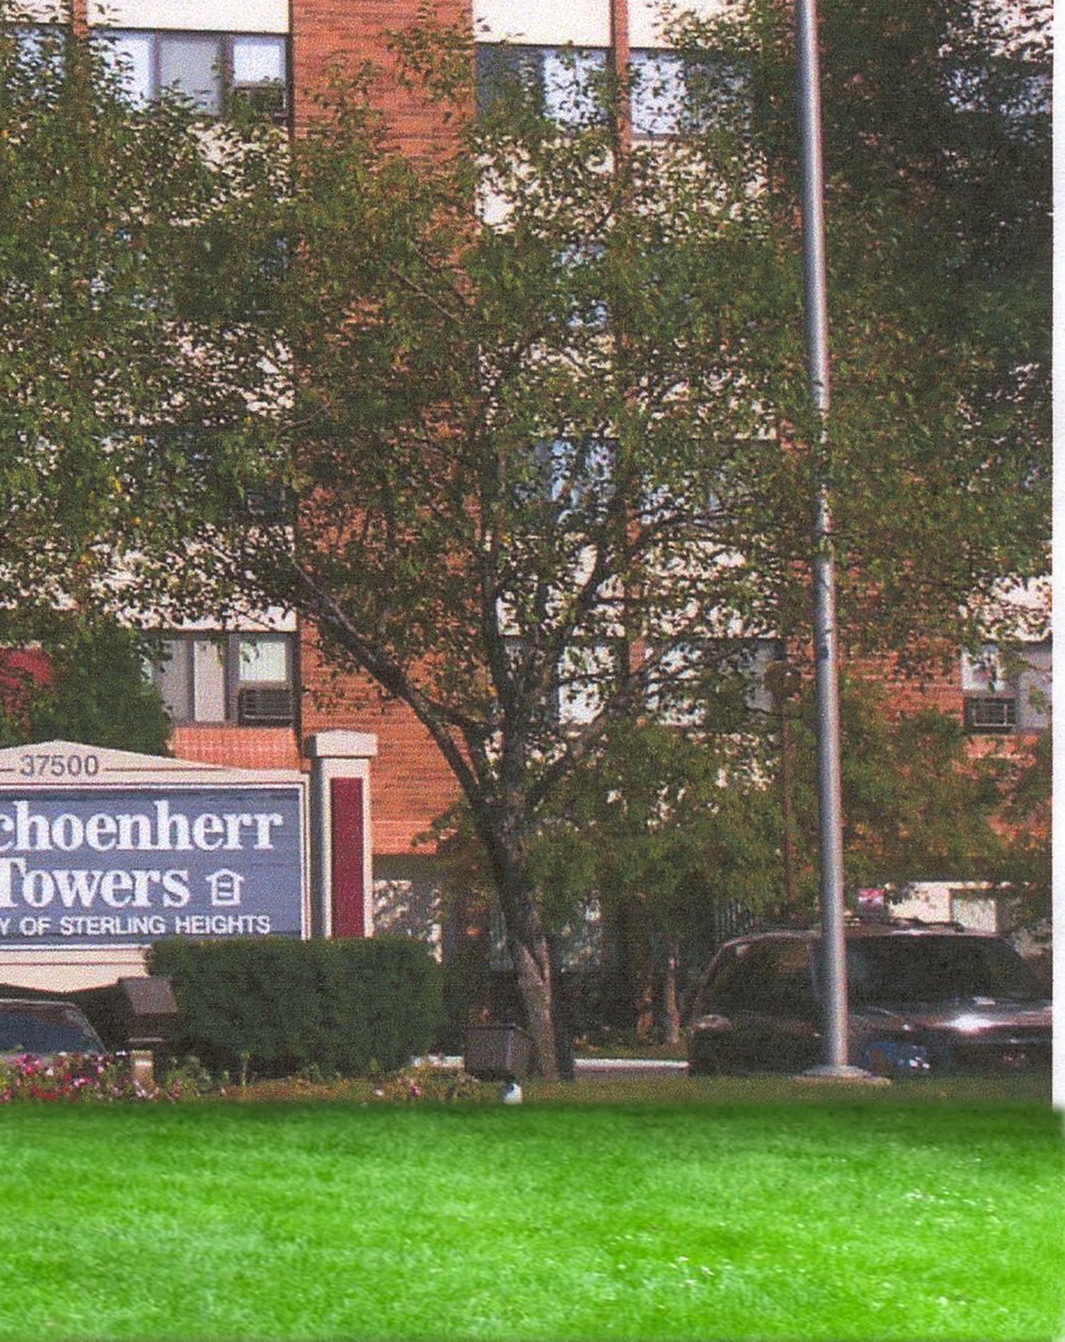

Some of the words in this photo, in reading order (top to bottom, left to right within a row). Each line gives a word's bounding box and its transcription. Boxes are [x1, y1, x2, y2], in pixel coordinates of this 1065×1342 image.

[19, 755, 100, 777] 37500
[20, 917, 52, 936] OF
[60, 915, 165, 936] STERLING
[175, 914, 270, 935] HEIGHTS
